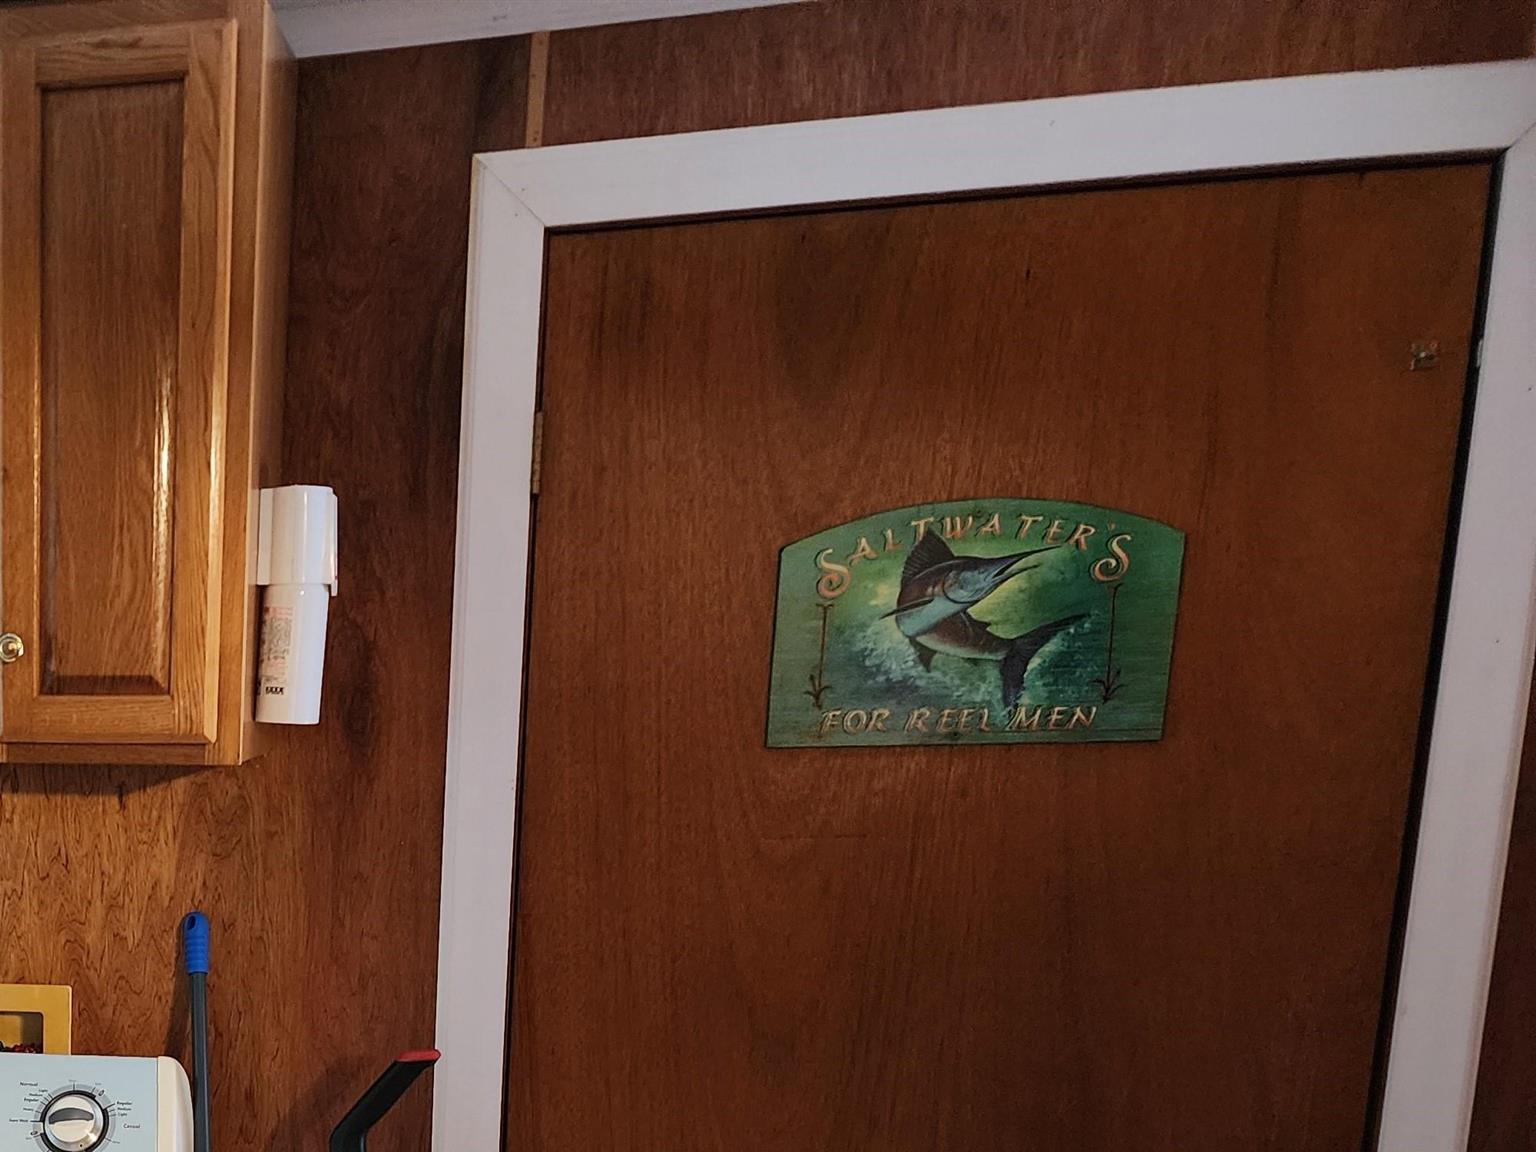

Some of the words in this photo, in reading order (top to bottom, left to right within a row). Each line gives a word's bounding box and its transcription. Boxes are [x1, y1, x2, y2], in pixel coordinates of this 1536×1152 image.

[818, 709, 891, 735] FOR
[906, 706, 992, 733] REEL
[1005, 705, 1099, 732] MEN
